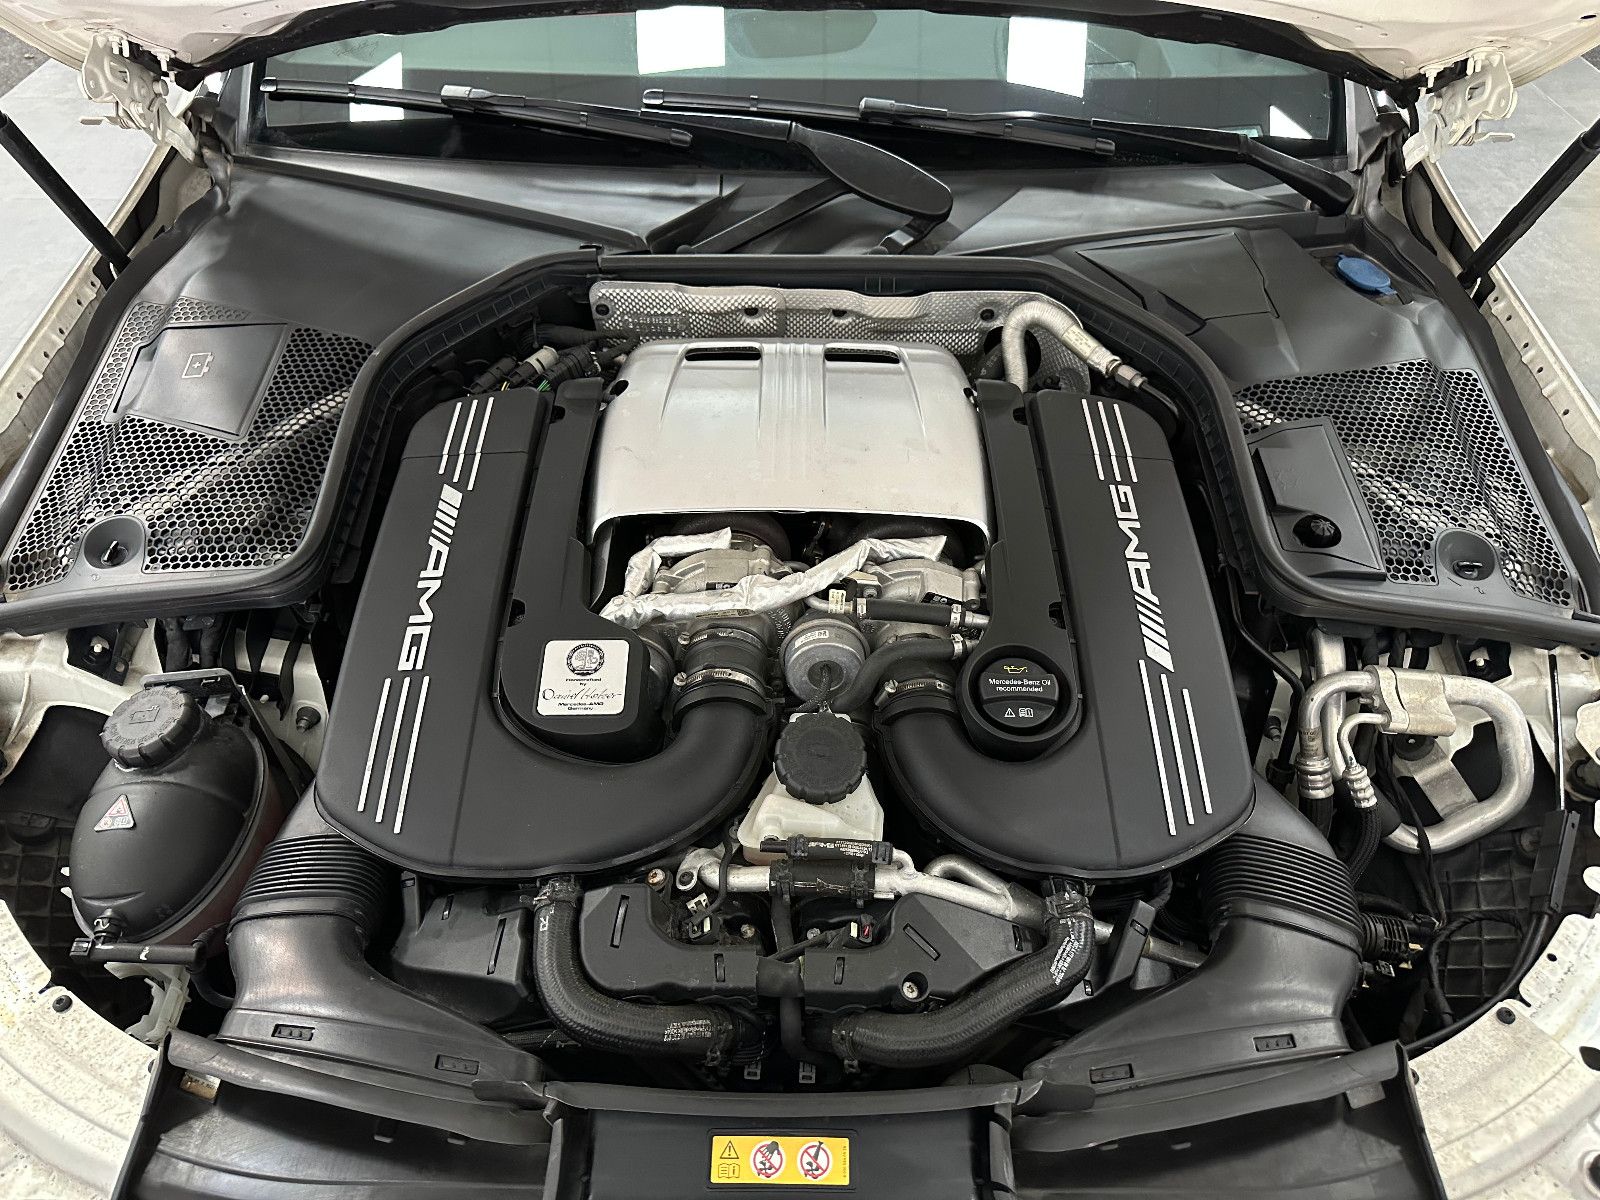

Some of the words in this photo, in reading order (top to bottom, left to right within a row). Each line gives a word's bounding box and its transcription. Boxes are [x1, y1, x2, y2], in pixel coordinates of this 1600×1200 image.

[398, 536, 450, 671] AMG
[1109, 484, 1160, 606] AMG
[988, 678, 1041, 686] Mercedes-Benz
